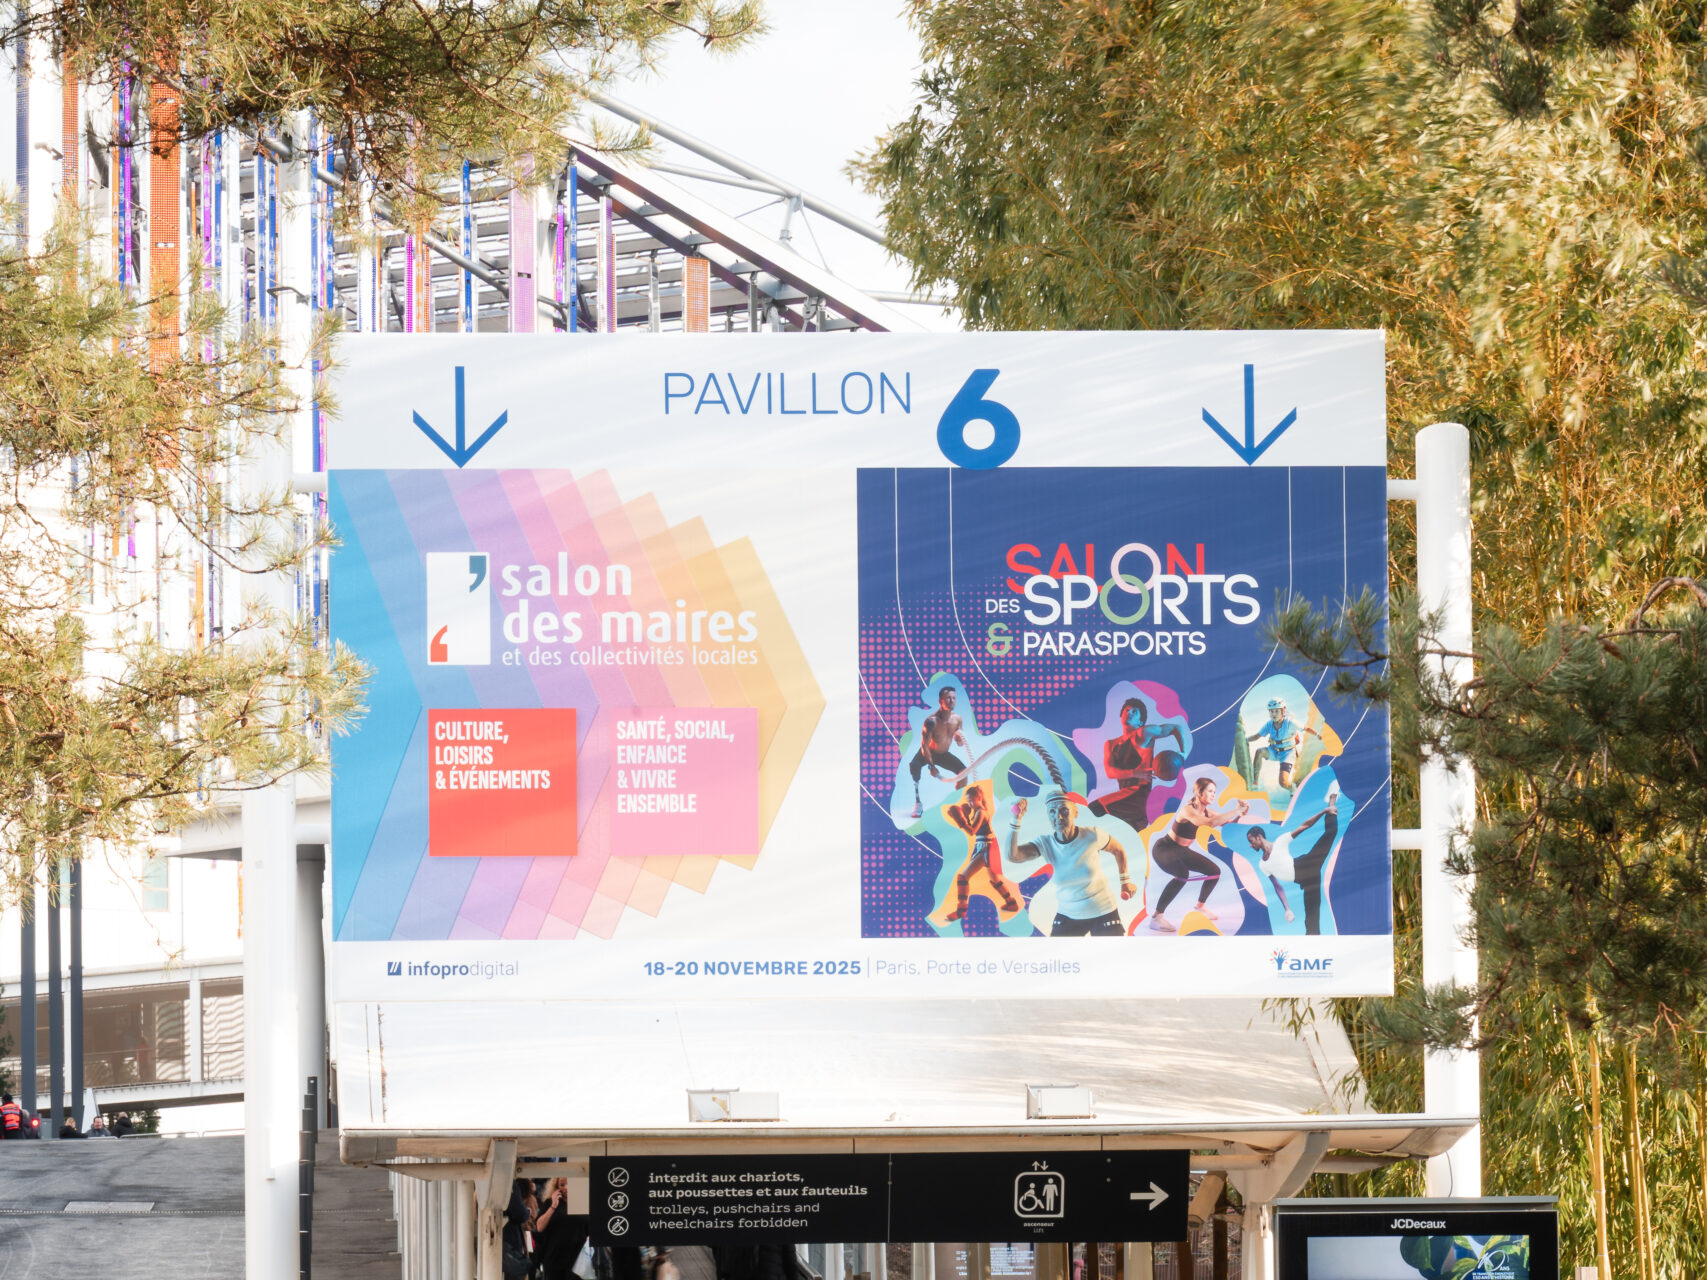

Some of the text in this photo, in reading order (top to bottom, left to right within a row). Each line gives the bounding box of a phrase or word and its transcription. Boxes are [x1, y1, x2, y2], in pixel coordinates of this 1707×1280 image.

[663, 369, 1021, 469] PAVILLON 6
[502, 552, 632, 597] salon
[1006, 542, 1205, 593] SALON
[985, 573, 1260, 626] DES SPORTS
[502, 598, 758, 644] des maires
[986, 623, 1206, 656] & PARASPORTS
[502, 643, 758, 666] et des collectivités locales
[435, 721, 510, 744] CULTURE,
[616, 716, 735, 743] SANTÉ, SOCIAL,
[435, 745, 494, 765] LOISIRS
[617, 745, 687, 765] ENFANCE
[435, 766, 551, 790] & ÉVÉNEMENTS
[617, 770, 676, 789] & VIVRE
[617, 794, 697, 813] ENSEMBLE
[407, 958, 519, 981] infoprodigital
[643, 960, 700, 977] 18-20
[703, 960, 808, 977] NOVEMBRE
[811, 958, 861, 976] 2025
[926, 958, 973, 975] Porte
[978, 958, 998, 974] de
[1002, 957, 1080, 974] Versailles
[648, 1171, 805, 1184] interdit aux chariots,
[648, 1185, 868, 1199] aux poussettes et aux fauteuils
[648, 1202, 820, 1217] trolleys, pushchairs and
[648, 1216, 808, 1230] wheelchairs forbidden
[1390, 1219, 1446, 1229] JCDecaux
